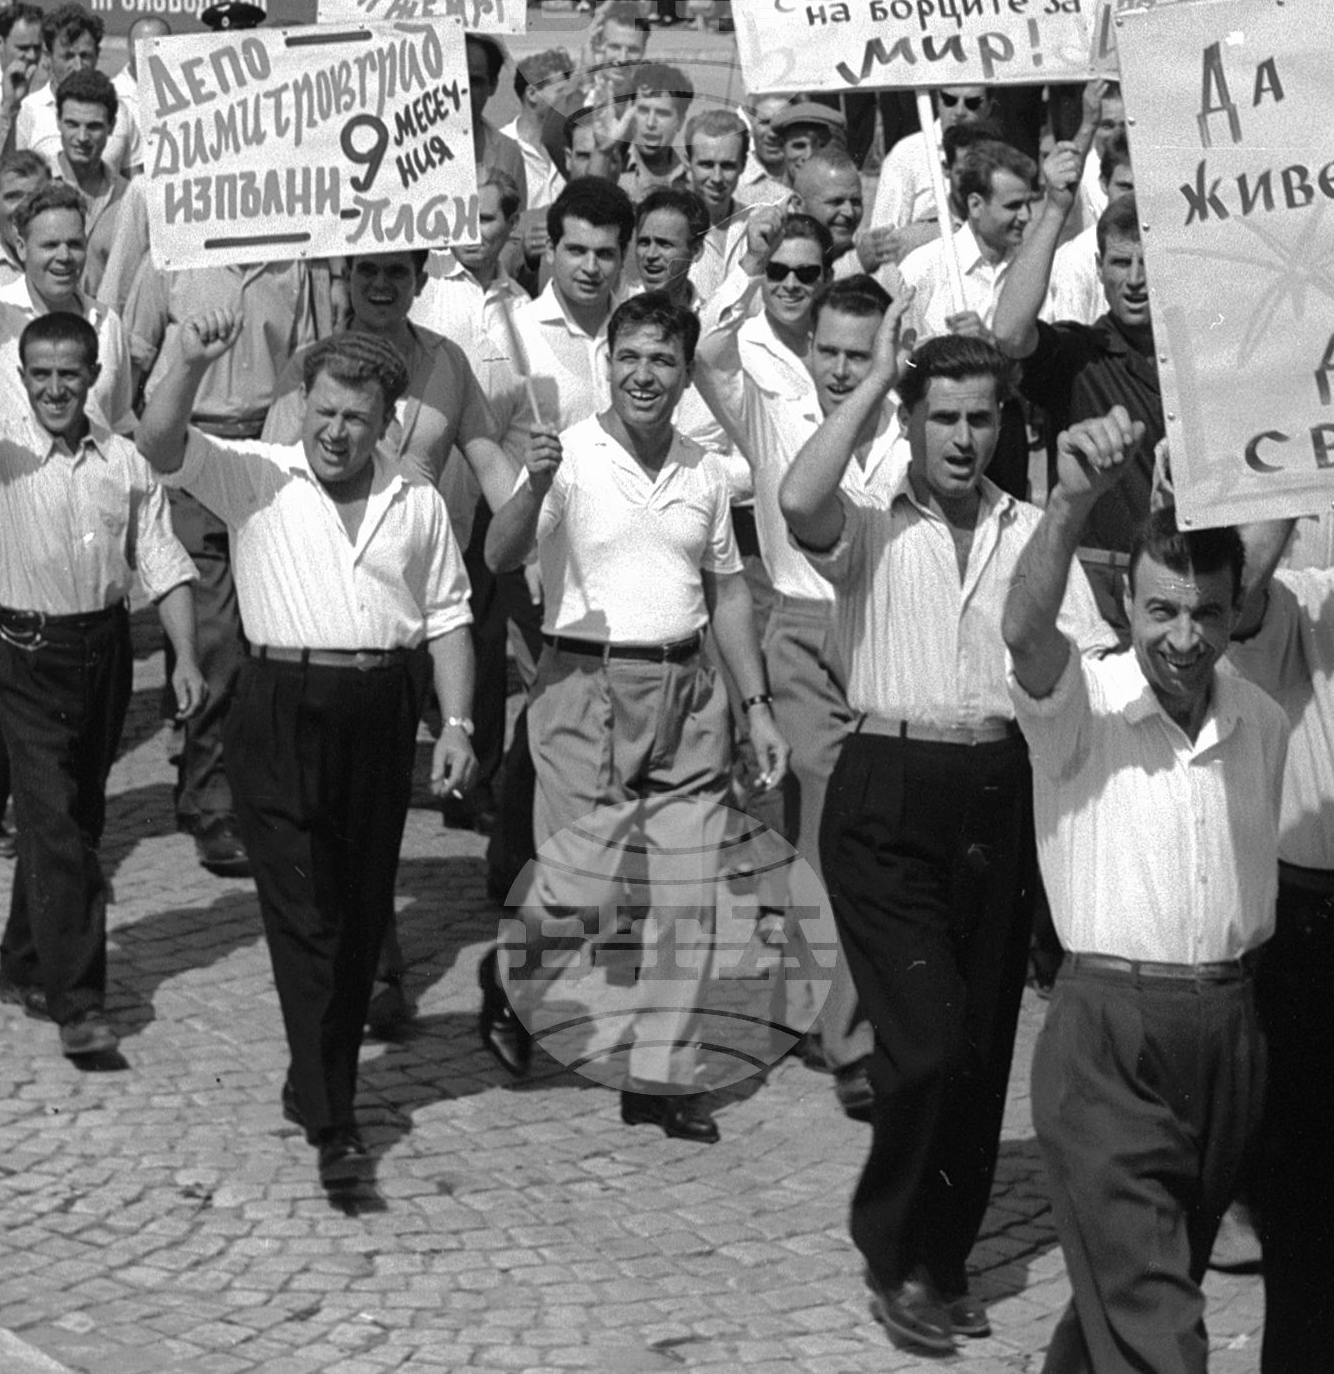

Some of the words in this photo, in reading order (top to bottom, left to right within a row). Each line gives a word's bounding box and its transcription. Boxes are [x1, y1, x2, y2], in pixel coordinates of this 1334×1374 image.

[806, 2, 851, 26] на
[148, 37, 272, 118] ДЕПО
[340, 114, 389, 192] 9
[396, 136, 455, 189] НИЯ
[165, 166, 341, 224] ИЗПЪЛНИ
